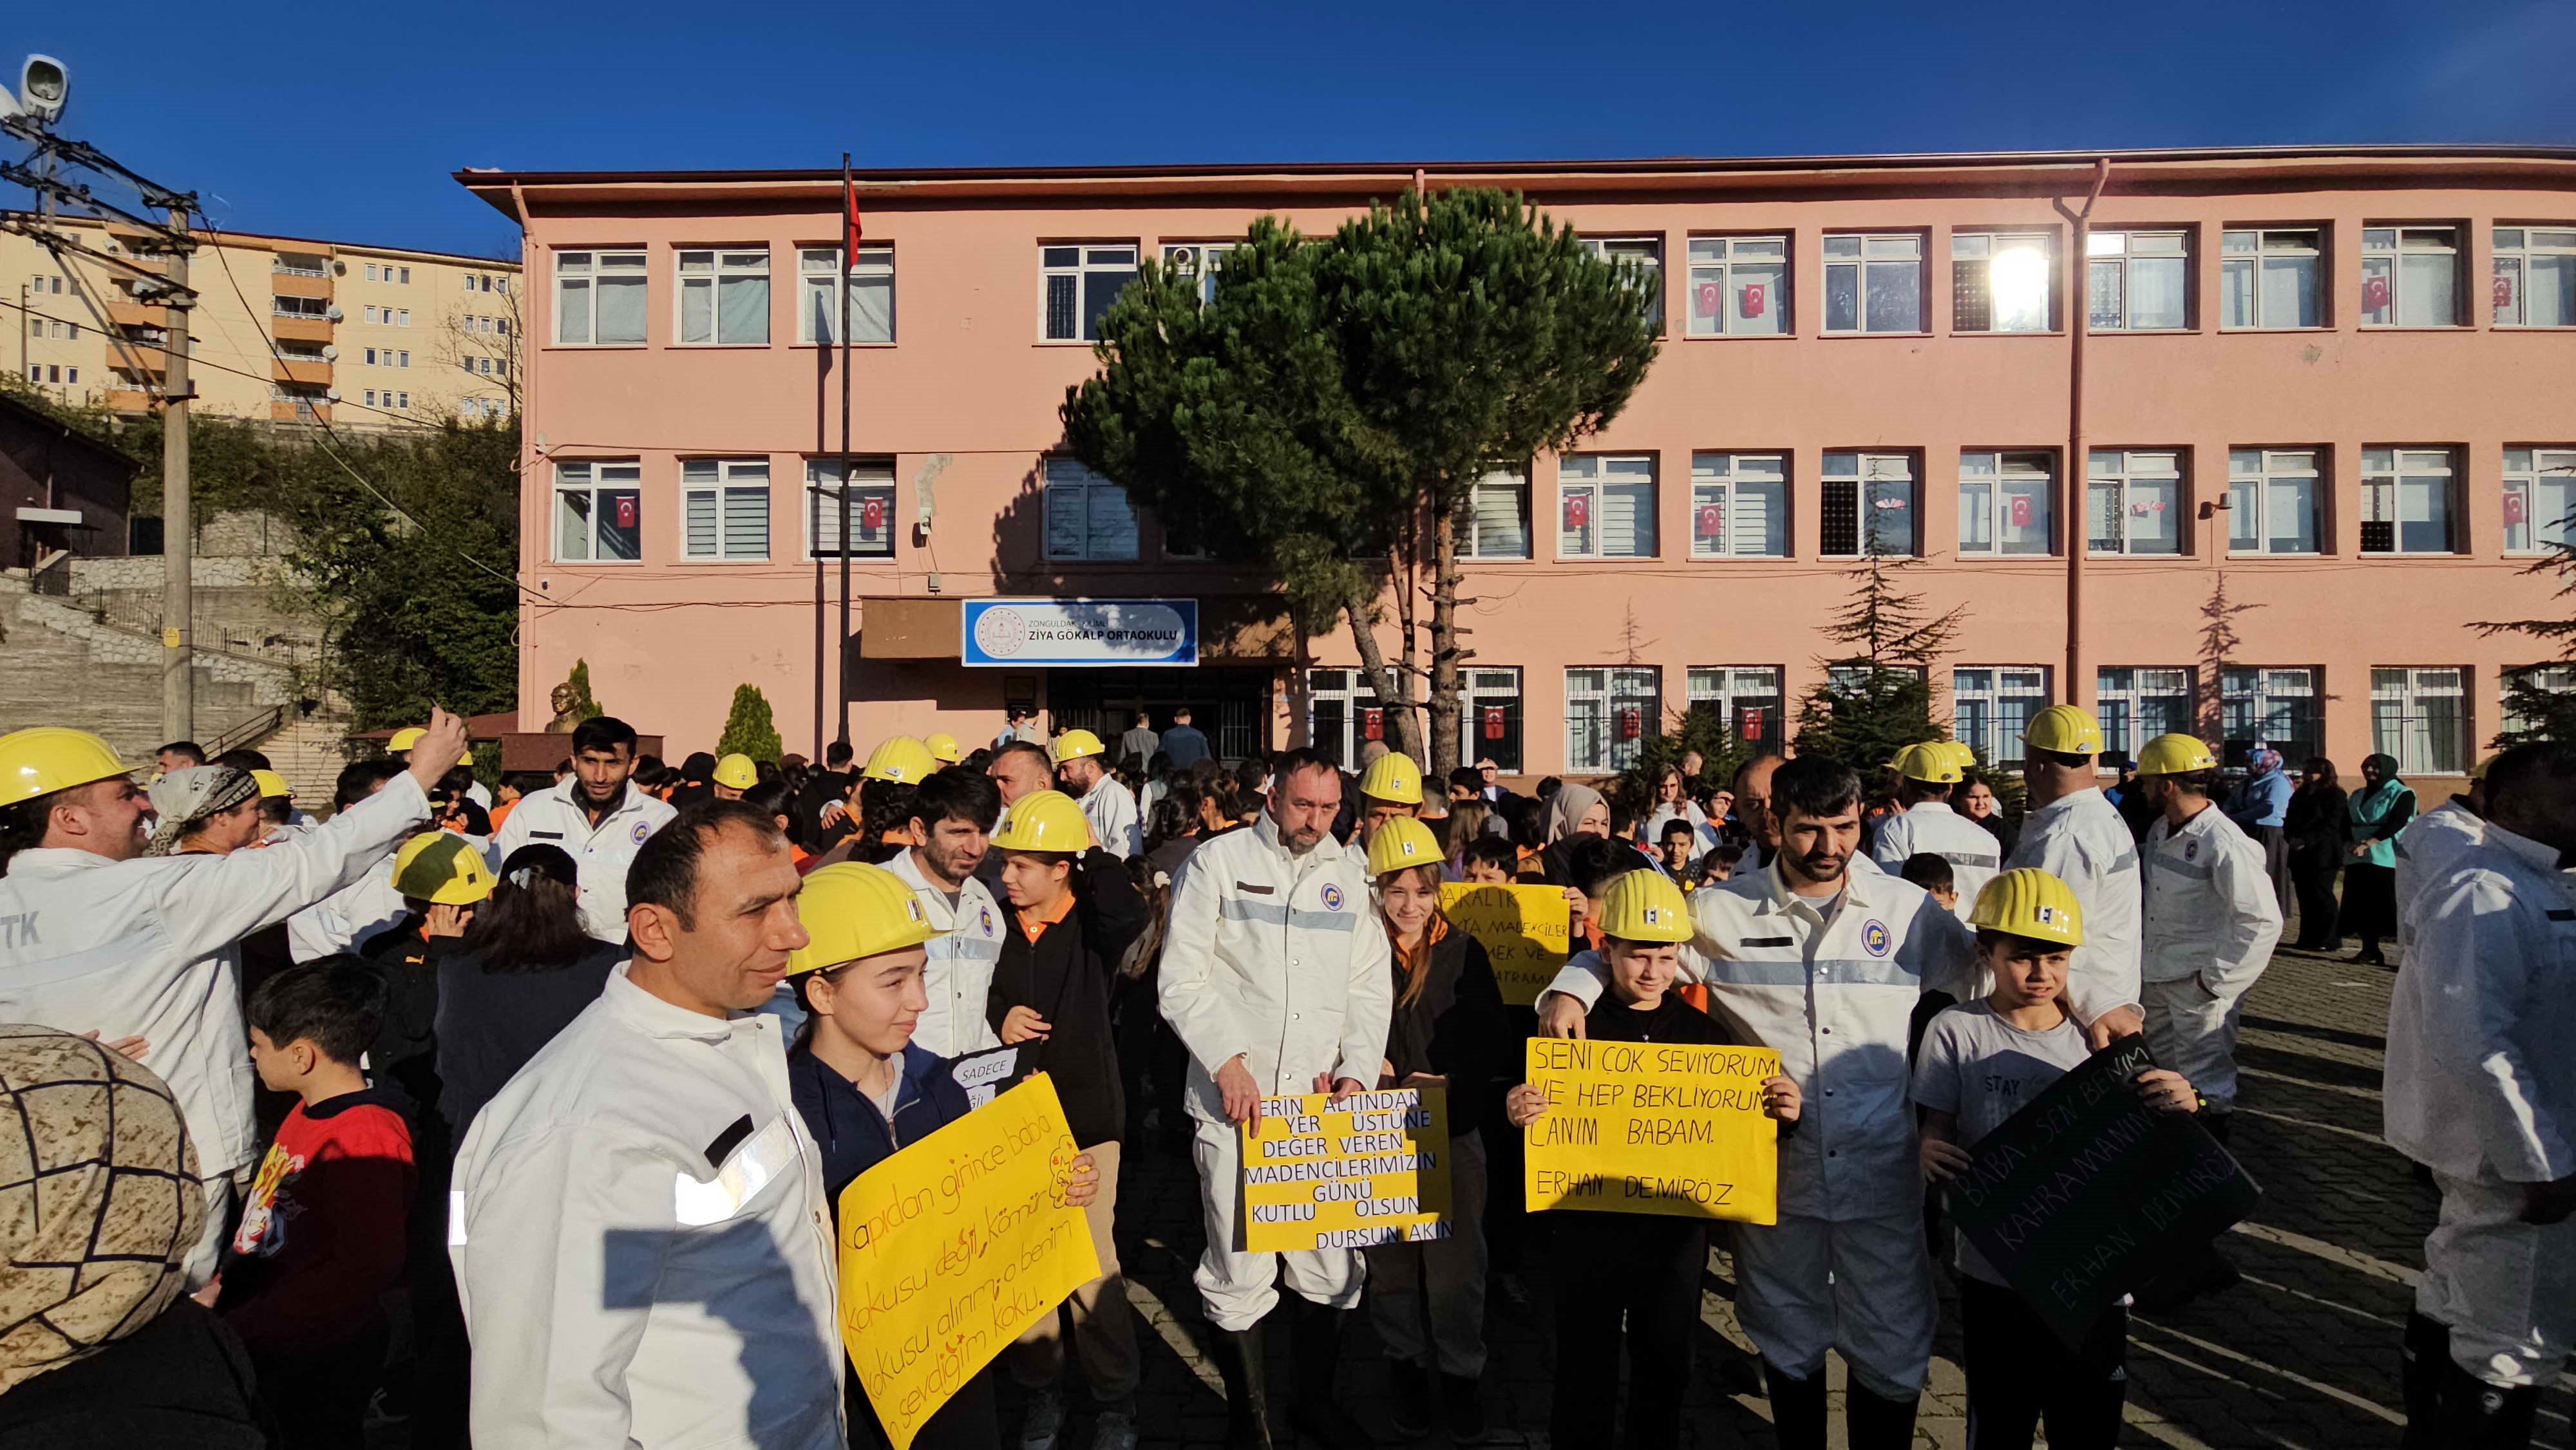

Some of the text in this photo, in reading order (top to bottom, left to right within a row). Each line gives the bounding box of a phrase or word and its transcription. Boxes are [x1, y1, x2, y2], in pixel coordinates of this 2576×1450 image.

[1028, 628, 1178, 641] ZİYA GÖKALP ORTAOKULU
[1525, 947, 1545, 960] VE
[961, 1060, 1007, 1082] SADECE
[1535, 1042, 1776, 1077] SENİ ÇOK SEVİYORUM
[1578, 1083, 1624, 1107] HEP
[1985, 1075, 2020, 1096] STAY
[1260, 1090, 1423, 1117] ERİN ALTINDAN
[1285, 1109, 1431, 1134] YER ÜSTÜNE
[1530, 1116, 1714, 1146] CANIM BABAM.
[1002, 1115, 1052, 1156] baba
[1262, 1133, 1403, 1158] DEĞER VEREN
[1244, 1150, 1437, 1185] MADENCİLERİMİZİN
[1312, 1178, 1373, 1202] GÜNÜ
[1537, 1170, 1734, 1205] ERHAN DEMİRÖZ
[1252, 1196, 1421, 1223] KUTLU OLSUN
[1316, 1220, 1454, 1250] DURSUN AKIN
[1004, 1263, 1016, 1283] o
[843, 1267, 929, 1346] kokusu
